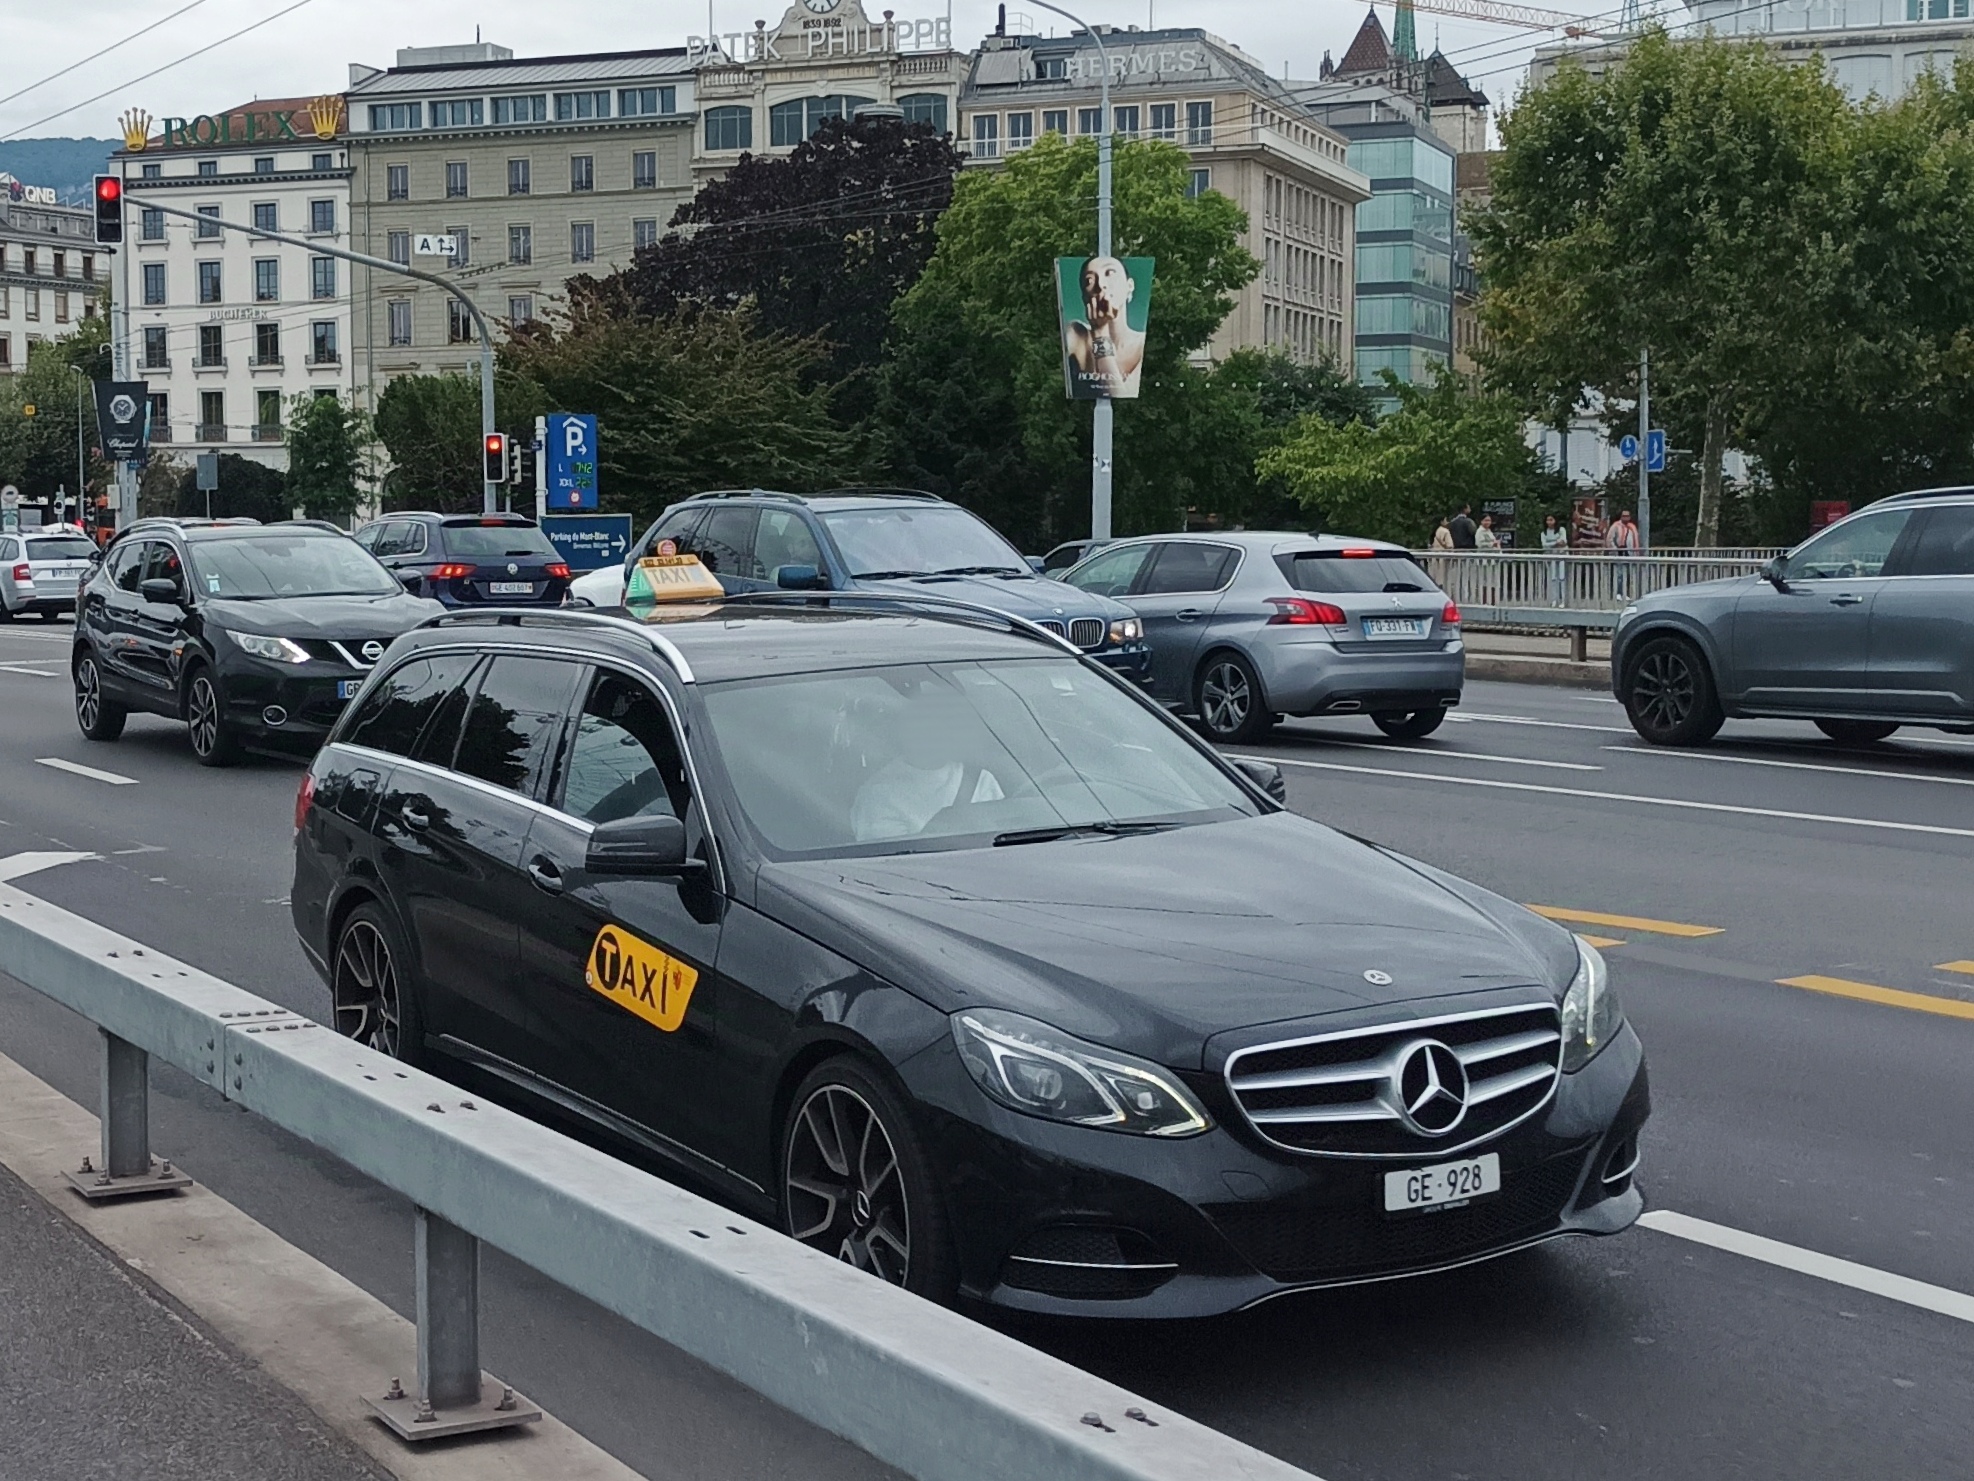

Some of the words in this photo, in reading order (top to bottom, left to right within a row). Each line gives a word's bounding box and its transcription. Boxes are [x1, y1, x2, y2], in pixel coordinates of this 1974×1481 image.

[686, 31, 782, 66] PATEK
[806, 17, 951, 58] PHILIPPE
[1064, 50, 1197, 79] HERMES
[162, 109, 299, 147] ROLEX
[24, 185, 56, 204] QNB
[420, 237, 431, 251] A
[208, 307, 269, 320] BUCHERER
[550, 531, 572, 543] Parking
[579, 531, 610, 541] Mont-Blanc
[648, 567, 692, 585] TAXI
[596, 932, 670, 1015] TAXI
